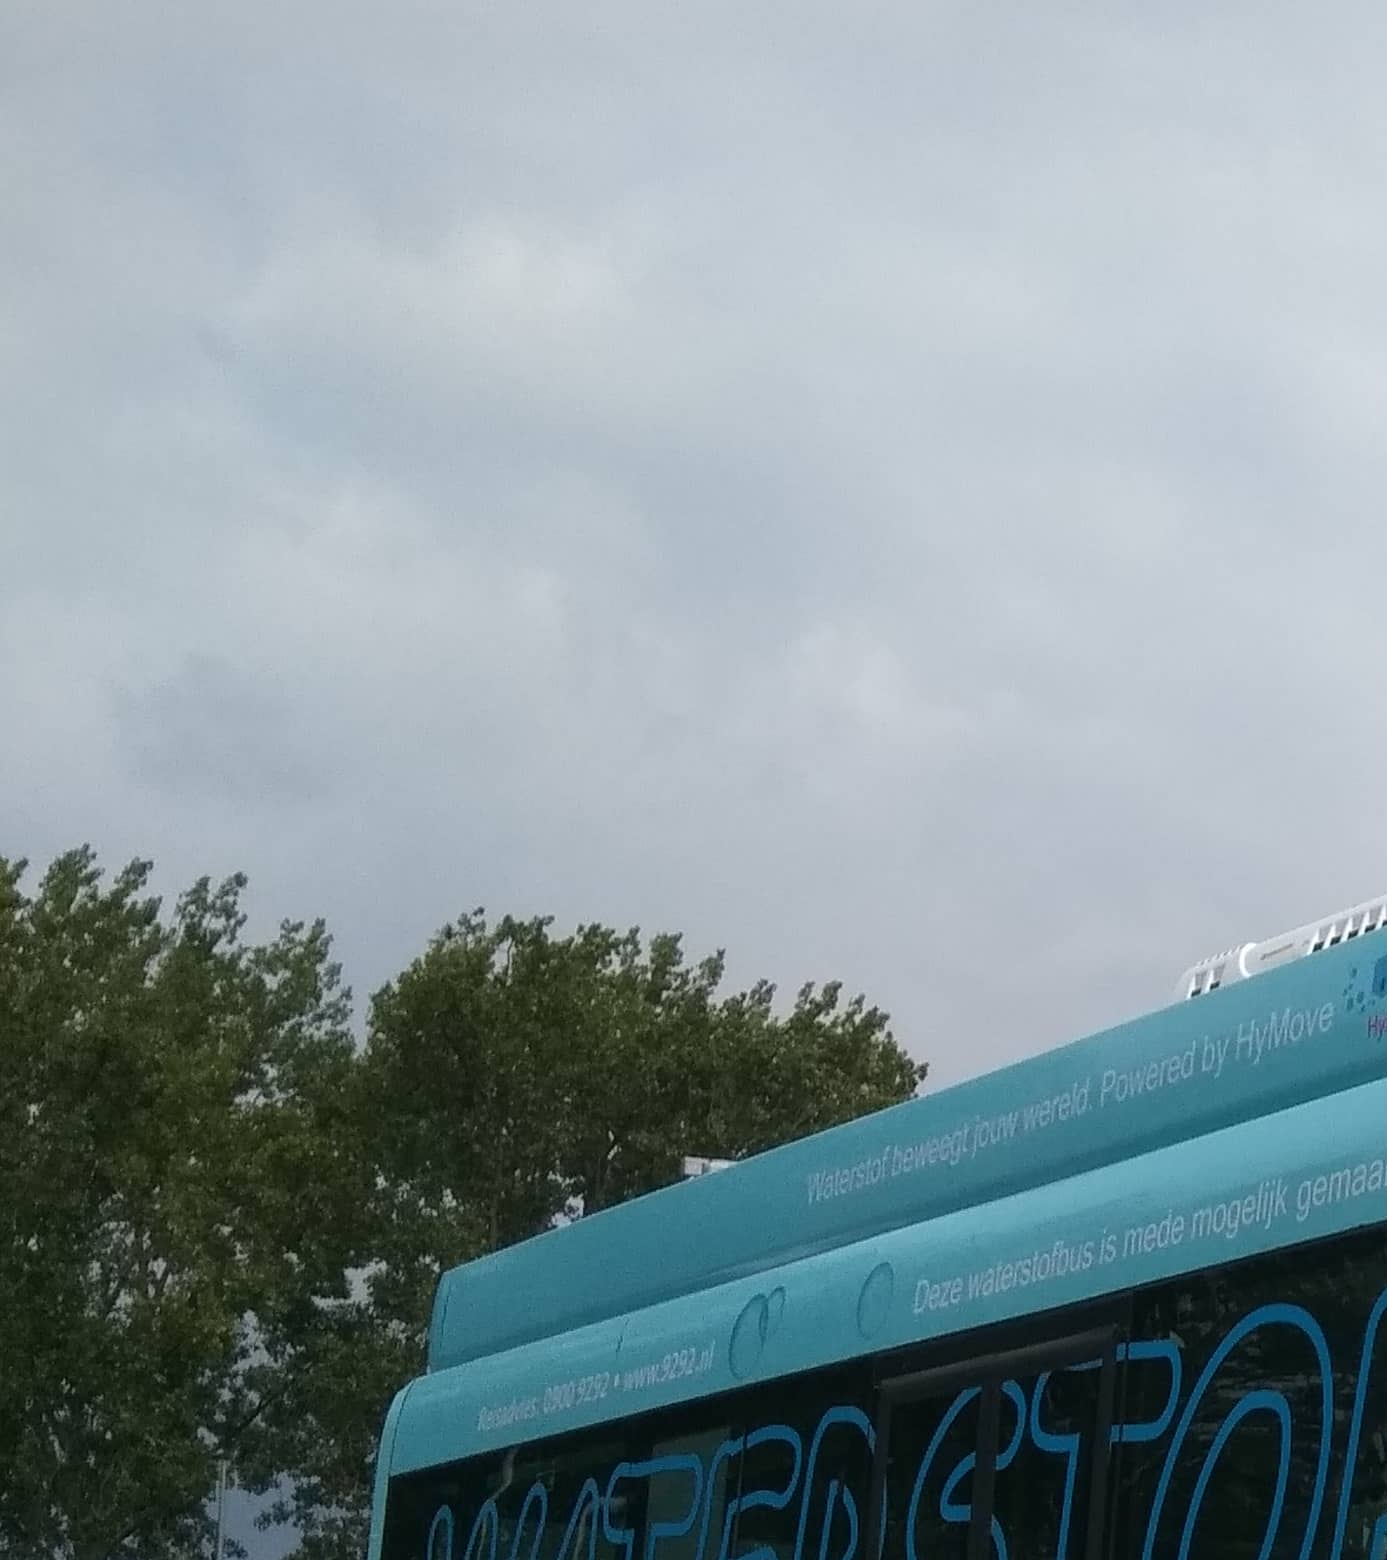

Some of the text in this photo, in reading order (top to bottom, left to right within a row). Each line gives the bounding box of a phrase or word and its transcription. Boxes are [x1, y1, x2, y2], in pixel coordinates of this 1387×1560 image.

[808, 1145, 890, 1204] Waterstof
[891, 1126, 969, 1175] beweegt
[972, 1110, 1018, 1159] jouw
[1101, 1041, 1196, 1106] Powered
[1202, 1037, 1229, 1079] by
[1236, 1002, 1336, 1064] HyMove
[913, 1279, 963, 1314] Deze
[968, 1240, 1095, 1298] waterstofbus
[1099, 1229, 1117, 1267] is
[1122, 1209, 1185, 1258] mede
[1190, 1177, 1289, 1240] mogelijk
